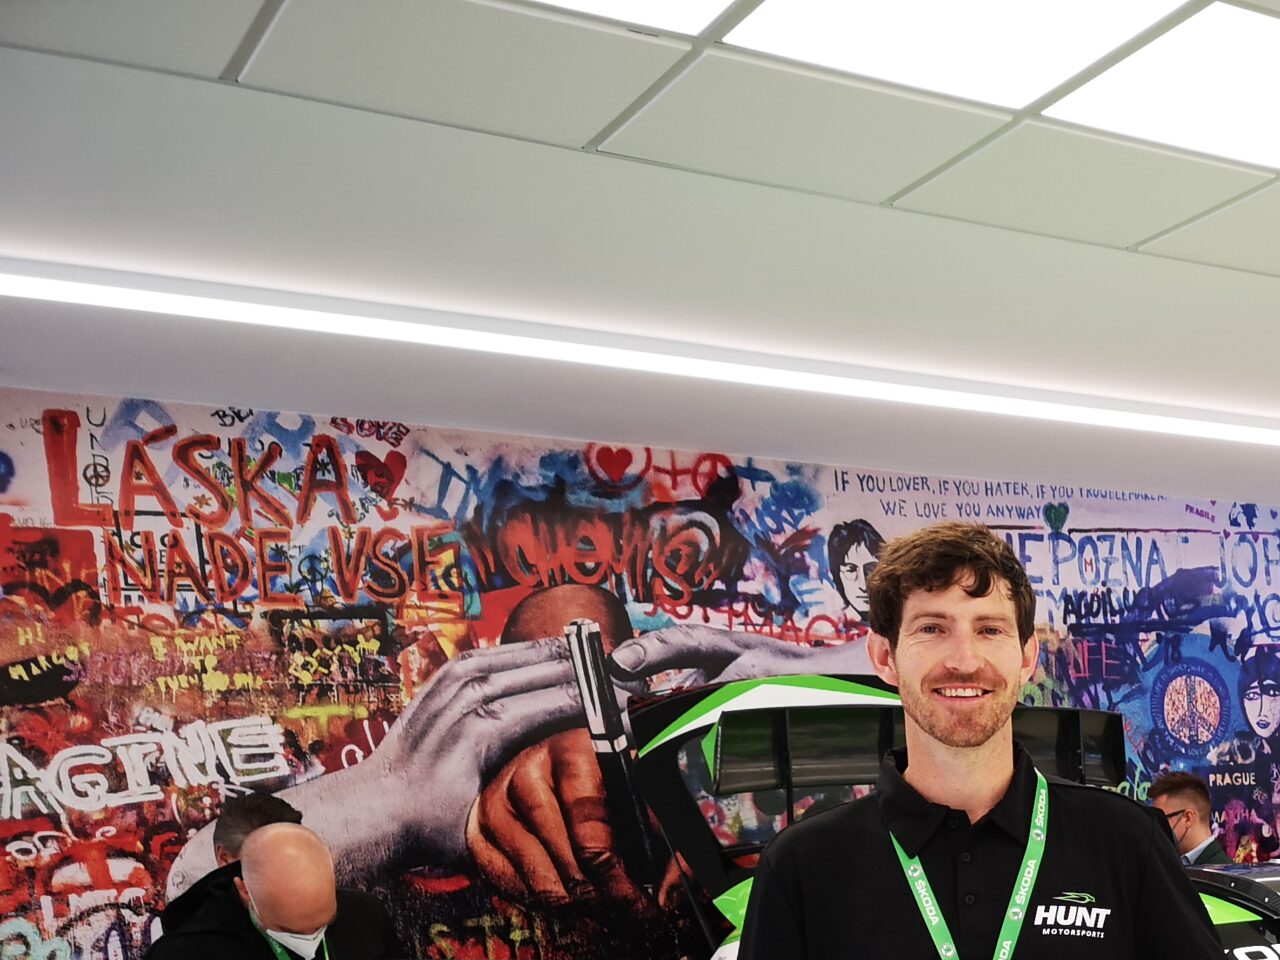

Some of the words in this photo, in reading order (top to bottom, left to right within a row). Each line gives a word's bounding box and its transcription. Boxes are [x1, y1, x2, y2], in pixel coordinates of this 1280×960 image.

[834, 470, 850, 492] IF
[857, 473, 886, 493] YOU
[954, 480, 980, 497] YOU
[880, 499, 907, 517] WE
[914, 502, 947, 519] LOVE
[955, 502, 981, 518] YOU
[986, 504, 1042, 520] ANYWAY
[1209, 772, 1256, 787] PRAGUE
[1015, 860, 1037, 905] ŠKODA
[1034, 905, 1111, 929] HUNT
[1042, 928, 1105, 939] MOTORSPORTS
